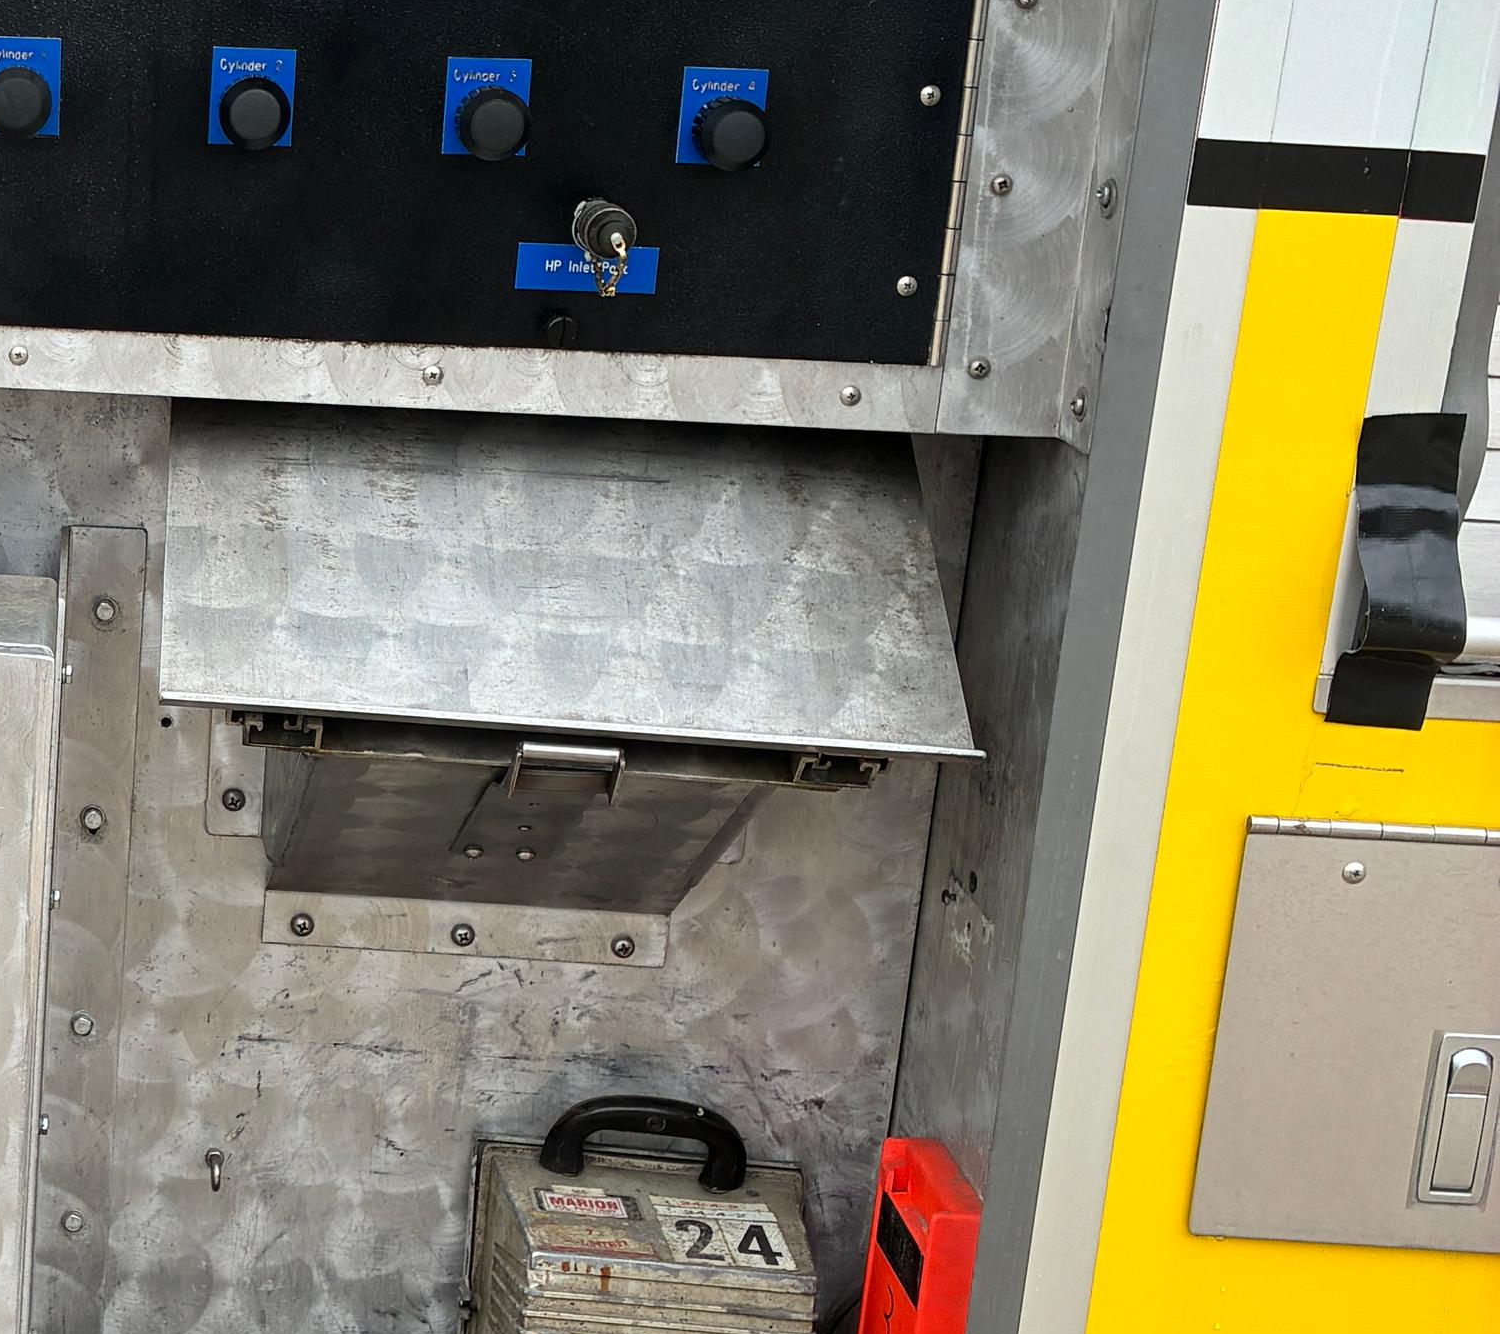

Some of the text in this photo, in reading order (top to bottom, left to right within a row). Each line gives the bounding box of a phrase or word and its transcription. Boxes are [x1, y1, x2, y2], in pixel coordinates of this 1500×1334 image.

[220, 57, 267, 73] Cylinder
[454, 69, 500, 83] Cylinder
[692, 78, 740, 94] Cylinder
[545, 259, 562, 272] HP
[601, 261, 628, 275] Pot
[548, 1196, 619, 1210] MARION
[674, 1219, 783, 1266] 24
